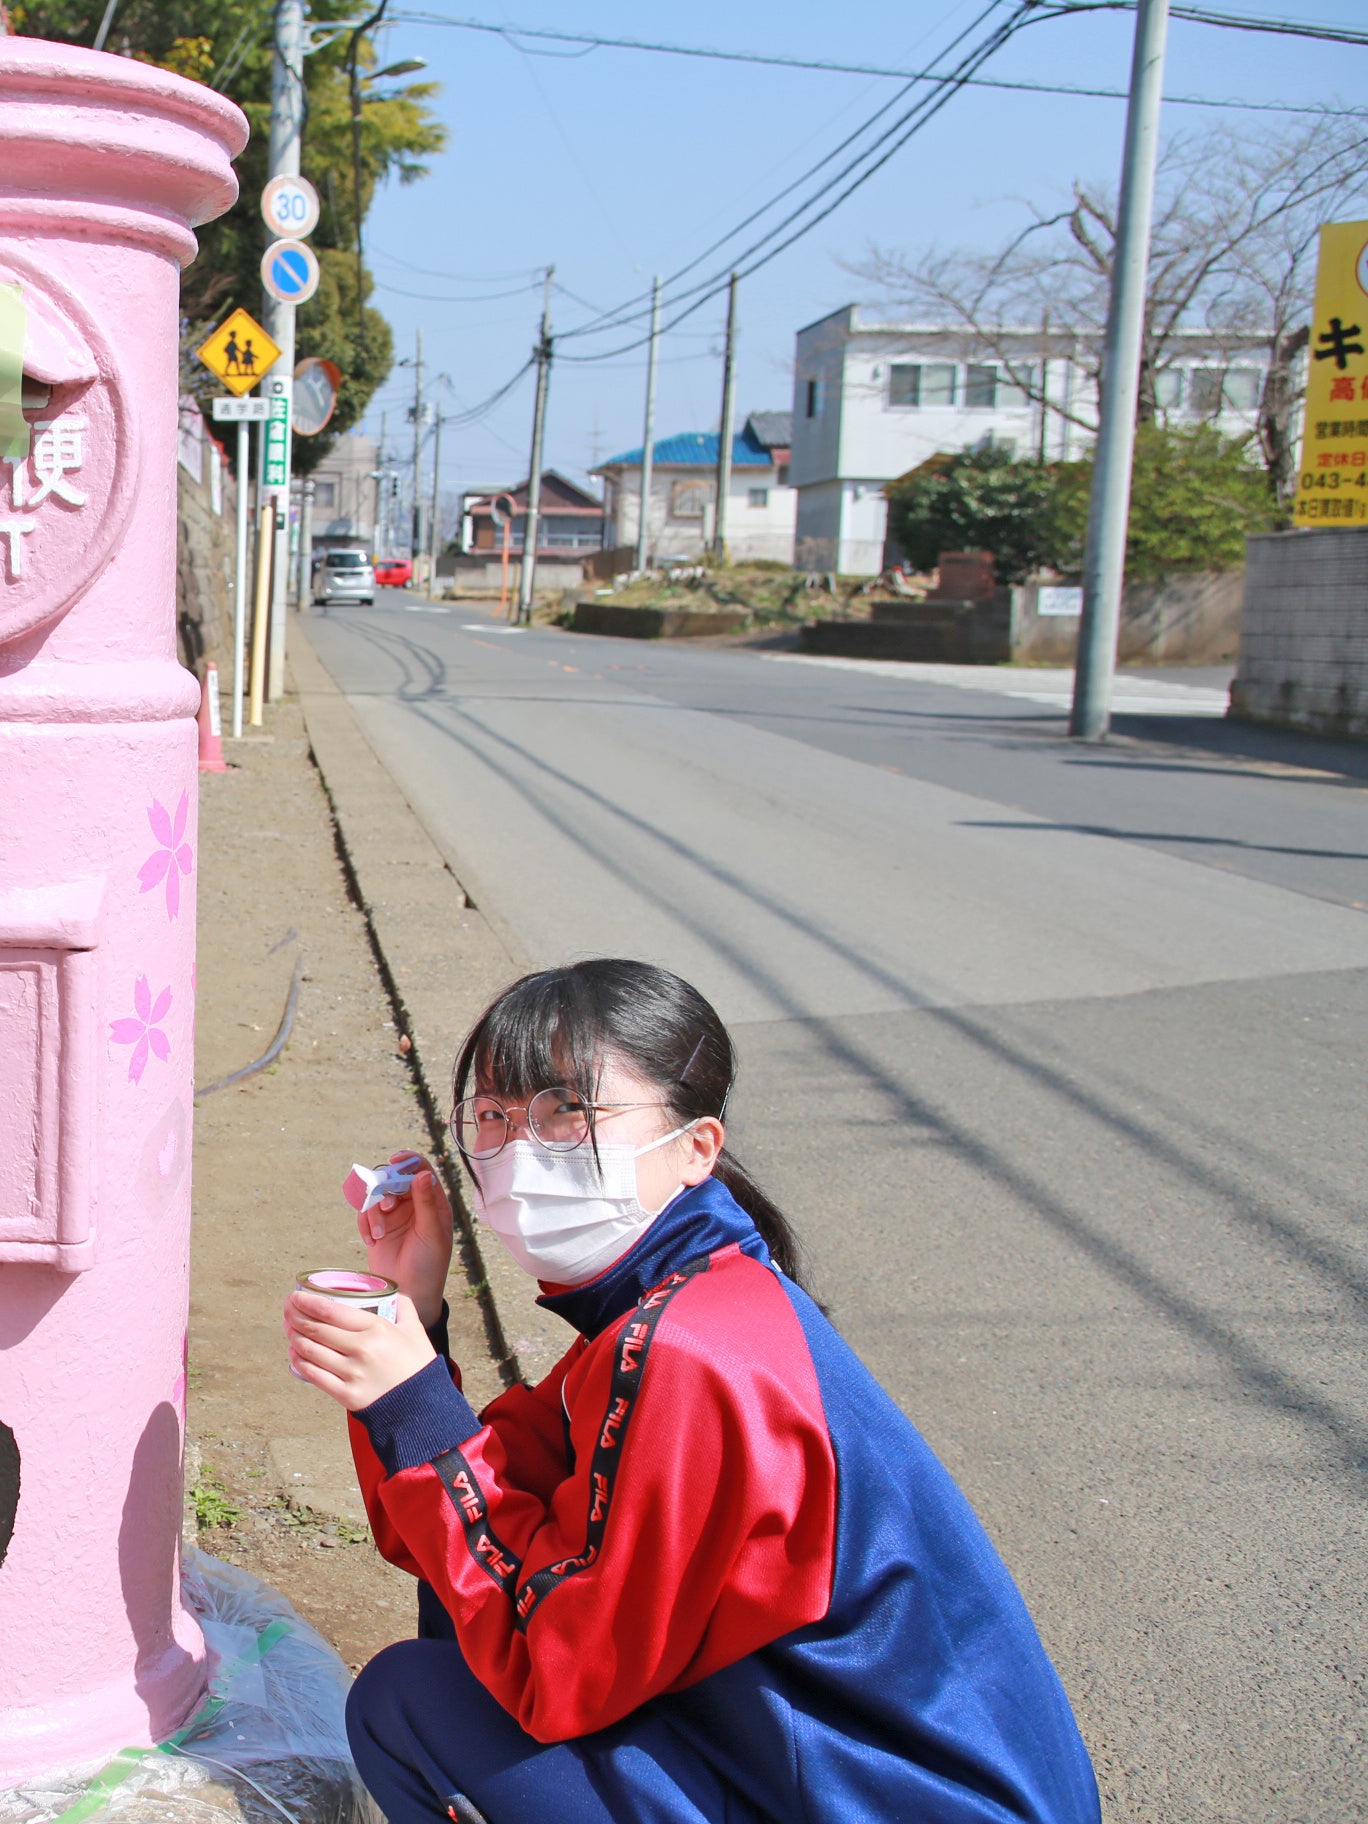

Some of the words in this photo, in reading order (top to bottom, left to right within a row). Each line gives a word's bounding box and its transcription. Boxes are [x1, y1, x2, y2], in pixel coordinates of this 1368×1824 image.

[276, 194, 307, 221] 30
[1301, 472, 1368, 490] 043-4
[620, 1323, 648, 1373] FILA
[601, 1397, 631, 1449] FILA
[453, 1470, 483, 1524] FILA
[590, 1472, 609, 1523] FILA
[476, 1534, 516, 1578] FILA
